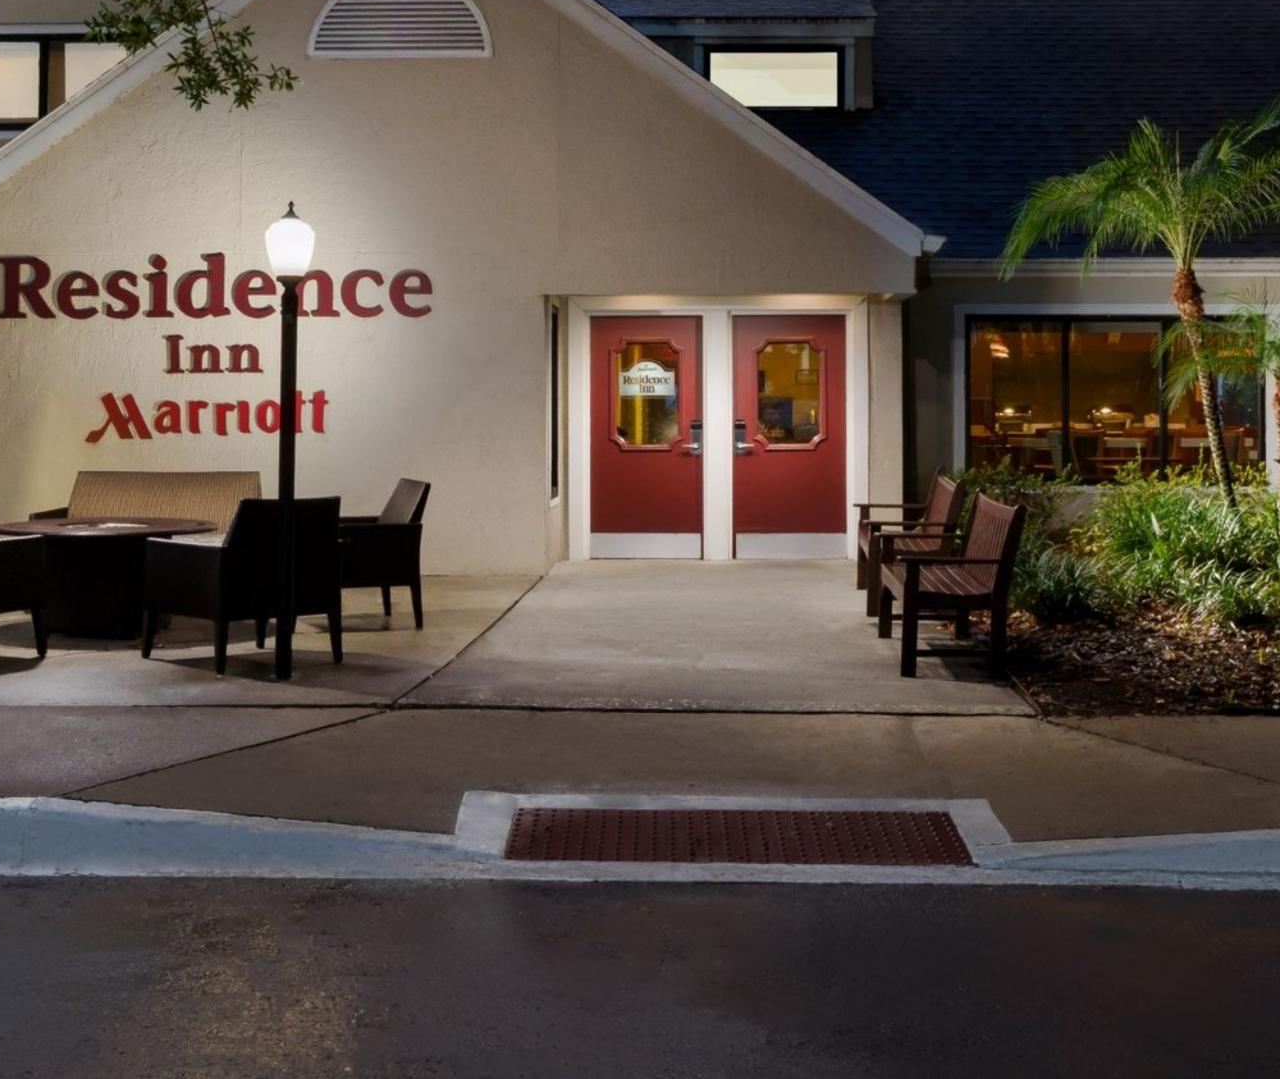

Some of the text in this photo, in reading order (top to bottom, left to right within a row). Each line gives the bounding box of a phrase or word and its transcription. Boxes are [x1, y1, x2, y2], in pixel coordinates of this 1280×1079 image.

[162, 334, 264, 375] Inn
[622, 375, 671, 385] Residence
[639, 384, 656, 393] Inn
[85, 390, 329, 443] Marriott
